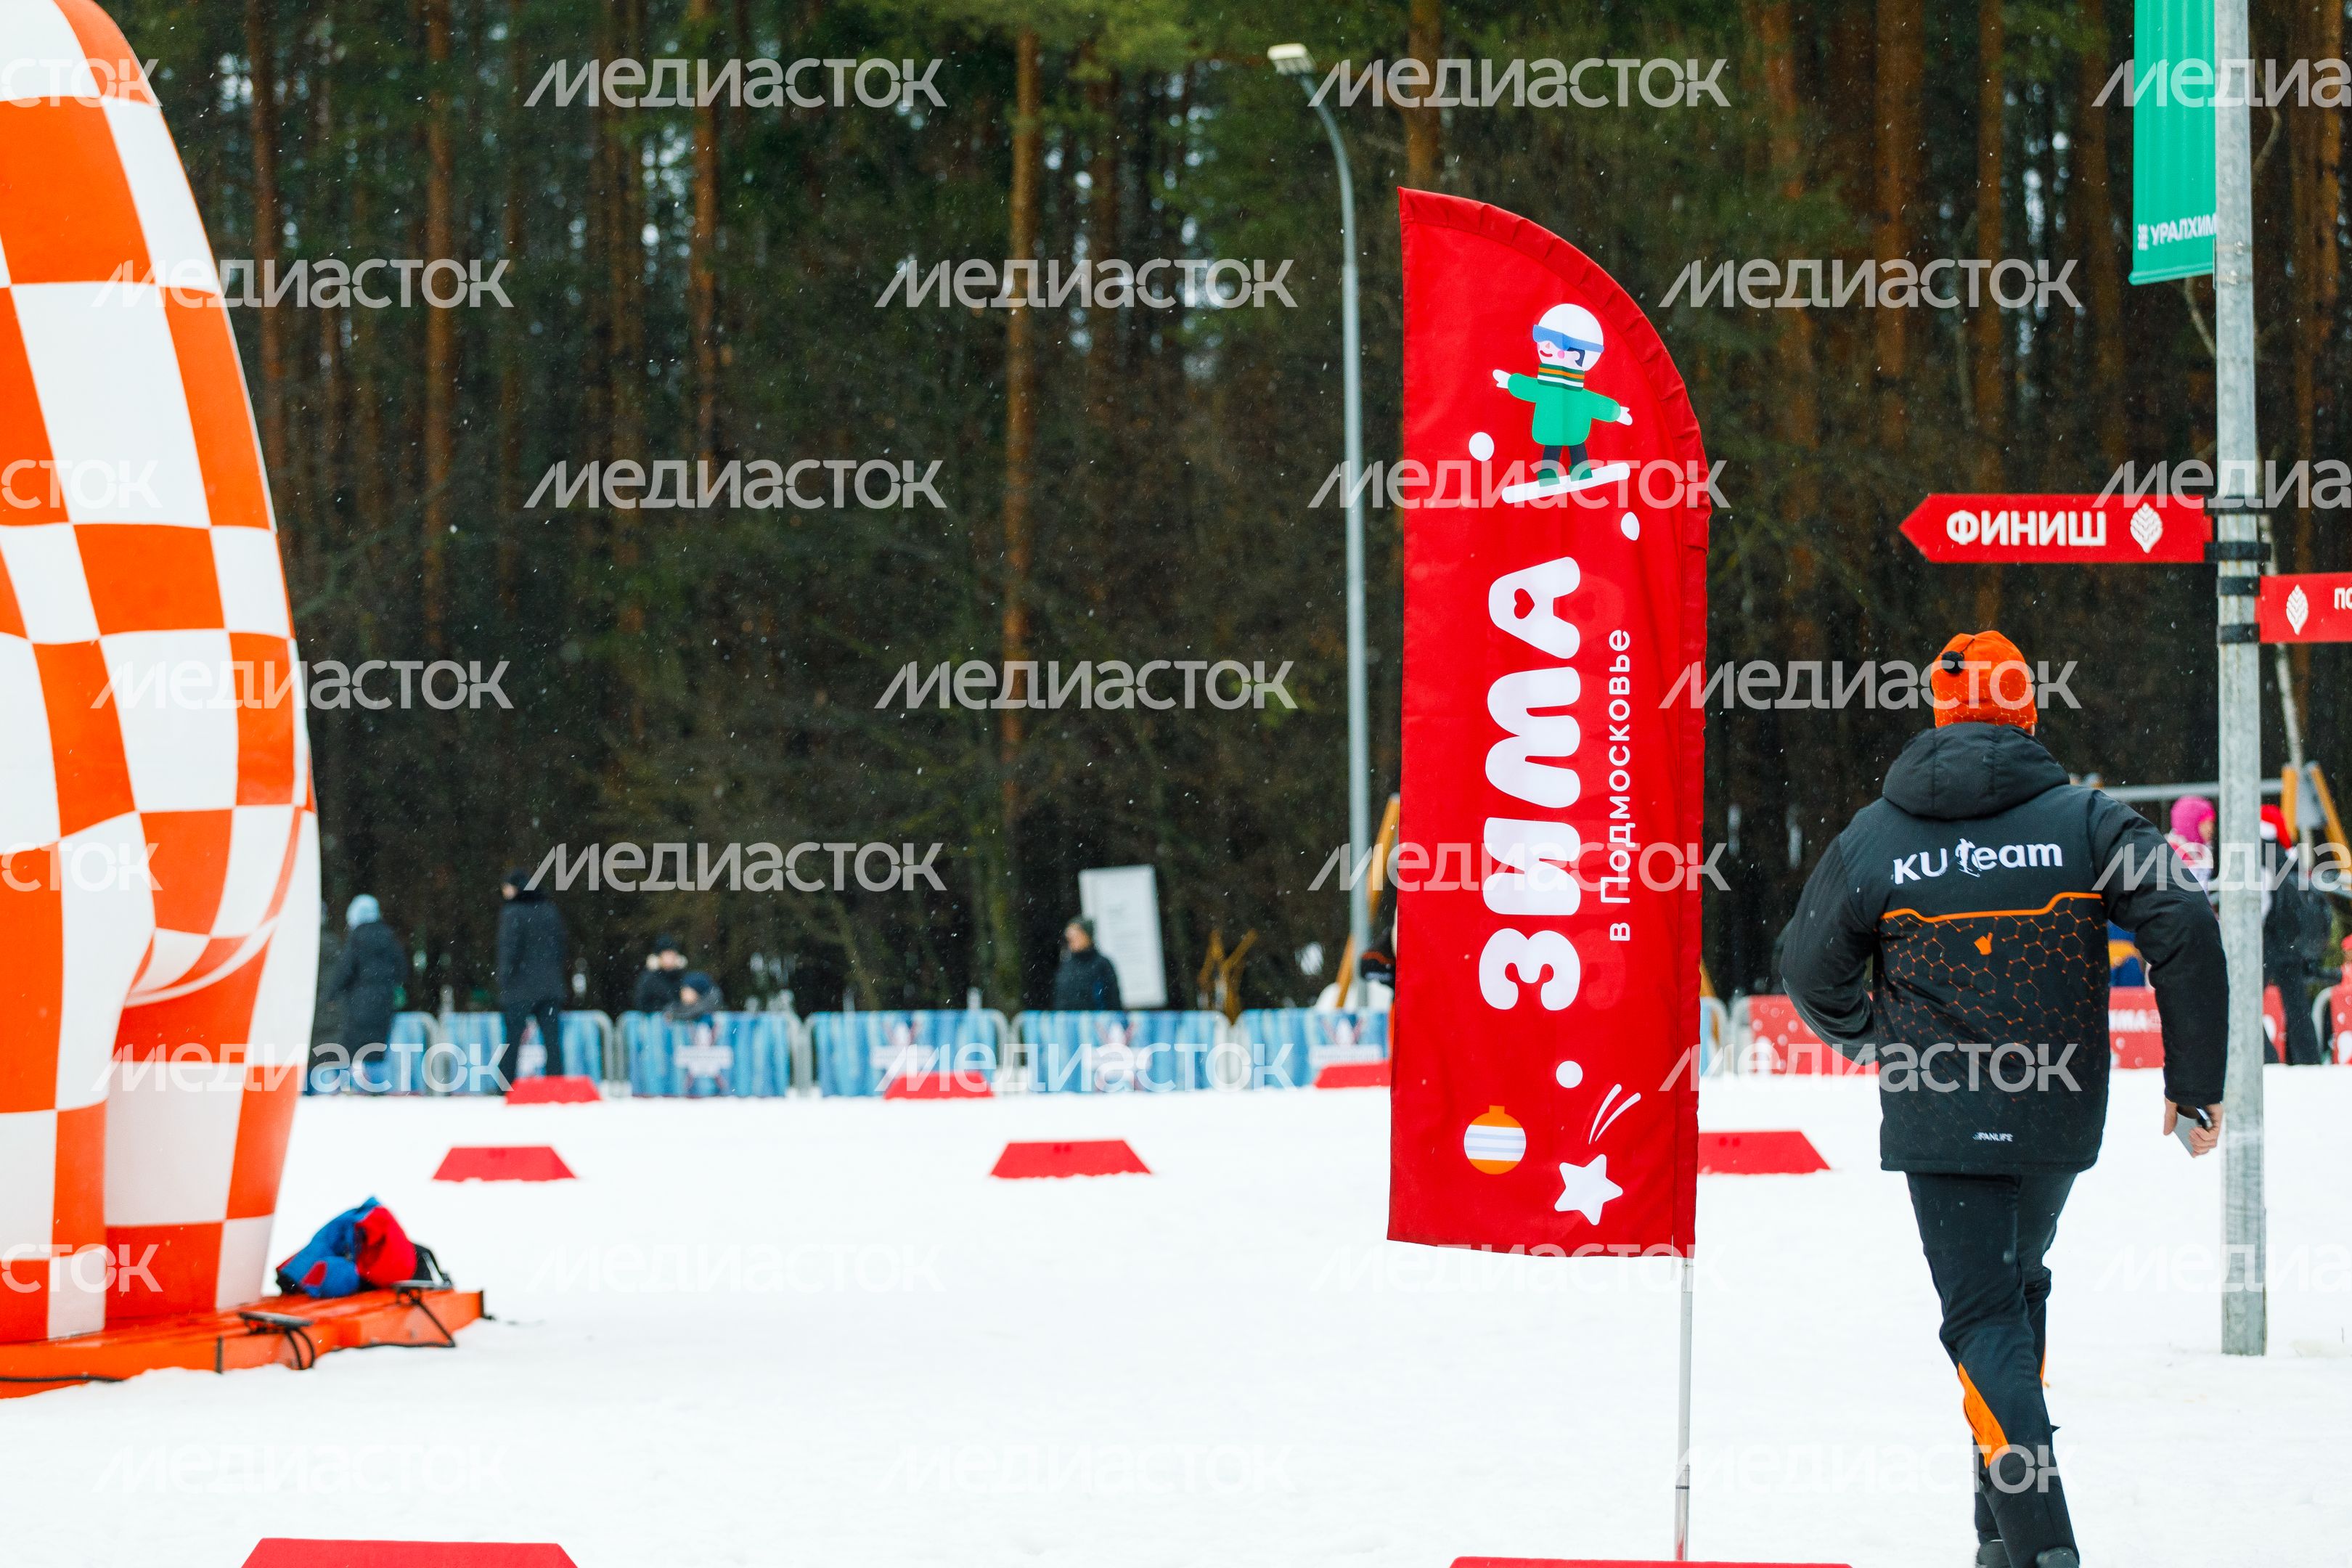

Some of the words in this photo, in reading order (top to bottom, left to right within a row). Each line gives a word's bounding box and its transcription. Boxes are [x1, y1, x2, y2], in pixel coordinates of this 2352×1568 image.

[2150, 213, 2218, 245] УРАЛХИМ
[1946, 510, 2106, 546] ФИНИШ
[1479, 556, 1580, 1010] ЗИМА
[1600, 629, 1635, 904] Подмосковье
[1892, 848, 1948, 885] KU
[1609, 922, 1630, 942] в
